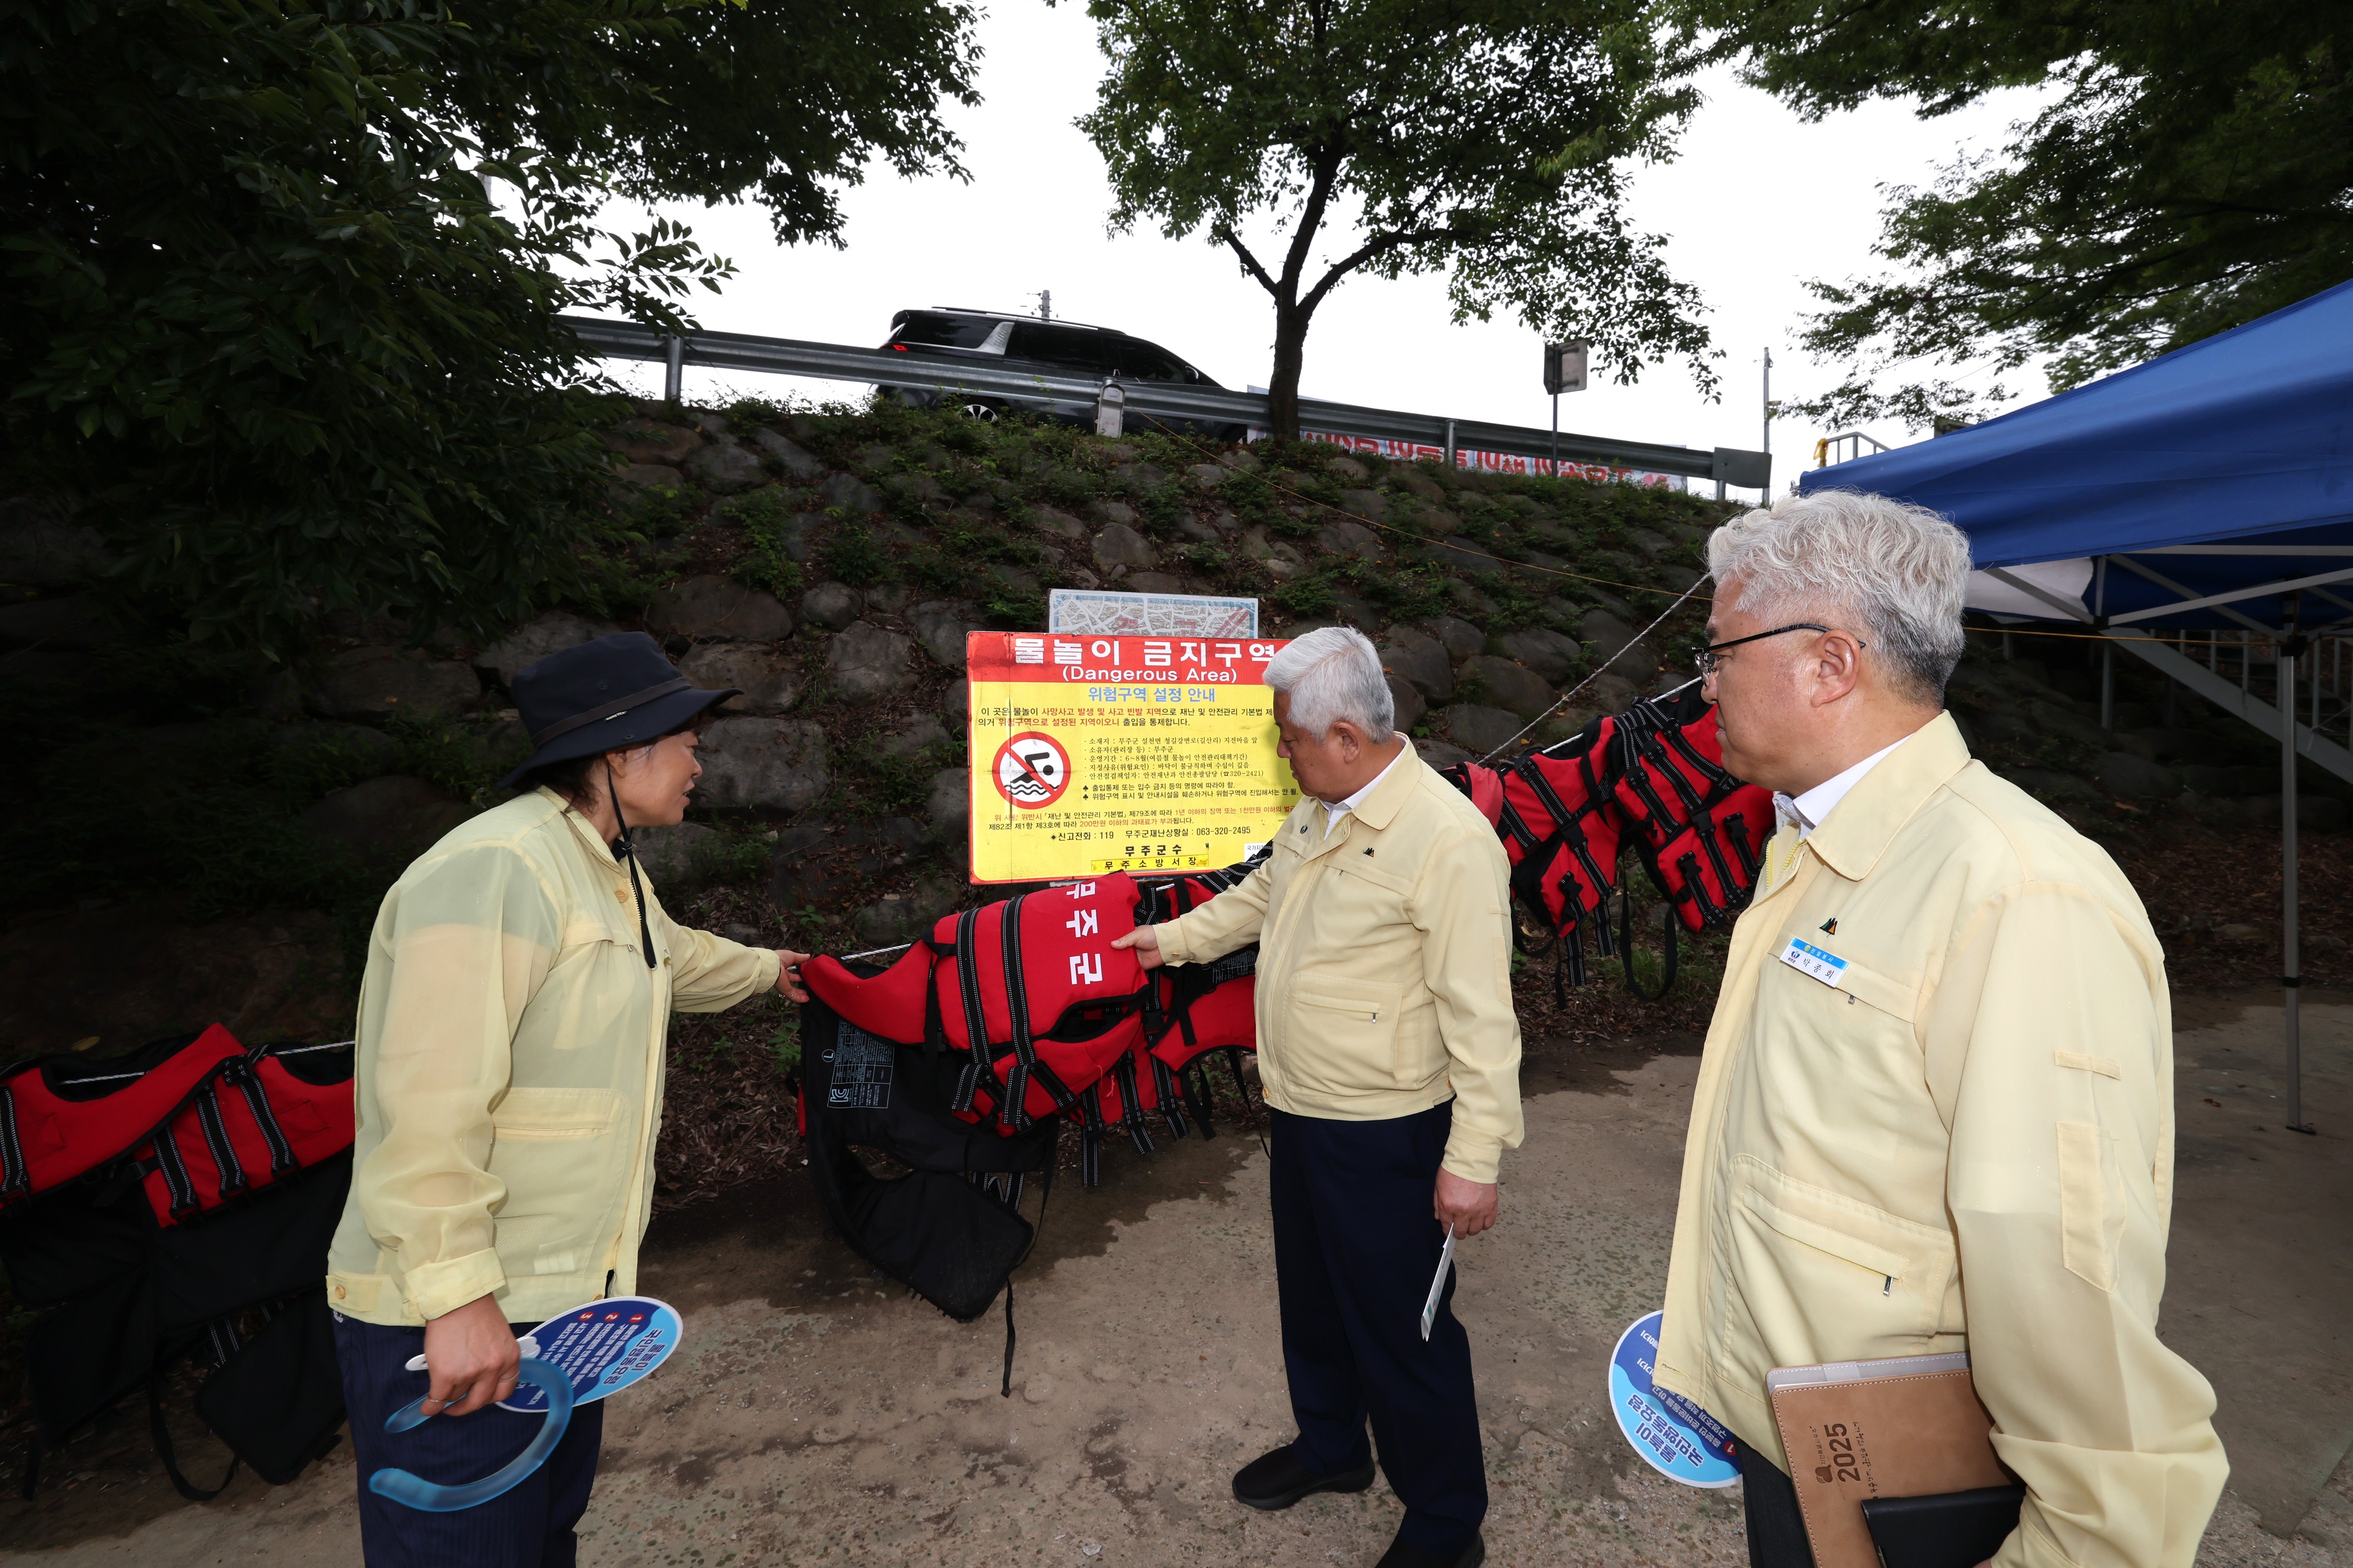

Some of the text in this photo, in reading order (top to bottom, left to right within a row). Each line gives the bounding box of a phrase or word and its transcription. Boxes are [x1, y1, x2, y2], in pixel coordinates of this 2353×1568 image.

[1014, 638, 1274, 667] 물놀이 금지구역
[1063, 666, 1237, 684] (Dangerous Area)
[1089, 687, 1215, 702] 위험구역 설정 안내
[981, 707, 989, 716] 이
[993, 707, 1009, 716] 곳은
[1013, 707, 1038, 716] 물놀이
[1042, 707, 1074, 716] 사망사고
[1078, 707, 1093, 716] 발생
[1097, 707, 1105, 716] 및
[1108, 707, 1123, 716] 사고
[1127, 707, 1143, 716] 빈발
[978, 718, 1190, 727] 의거 위험구역으로 설정된 지역이오니 출입을 통제합니다.
[1089, 763, 1150, 771] 지정사유(위험요인)
[1089, 772, 1140, 780] 안전점검책임자:
[1036, 821, 1061, 829] 제3호에
[1080, 819, 1106, 827] 200만원
[1058, 831, 1114, 841] 신고전화 119
[1126, 827, 1251, 839] 무주군재난상황실 063-320-2495
[1066, 881, 1103, 985] 무주군
[603, 1329, 664, 1385] 국민행동요령
[630, 1343, 666, 1371] 물놀이
[1684, 1399, 1700, 1415] 착용
[1652, 1385, 1722, 1448] 충분한 준비운동을 하고
[1698, 1411, 1727, 1439] 구명조끼
[1627, 1393, 1705, 1468] 국민행동요령
[1635, 1422, 1678, 1465] 물놀이
[1727, 1444, 1734, 1453] 1
[1823, 1423, 1861, 1483] 2025
